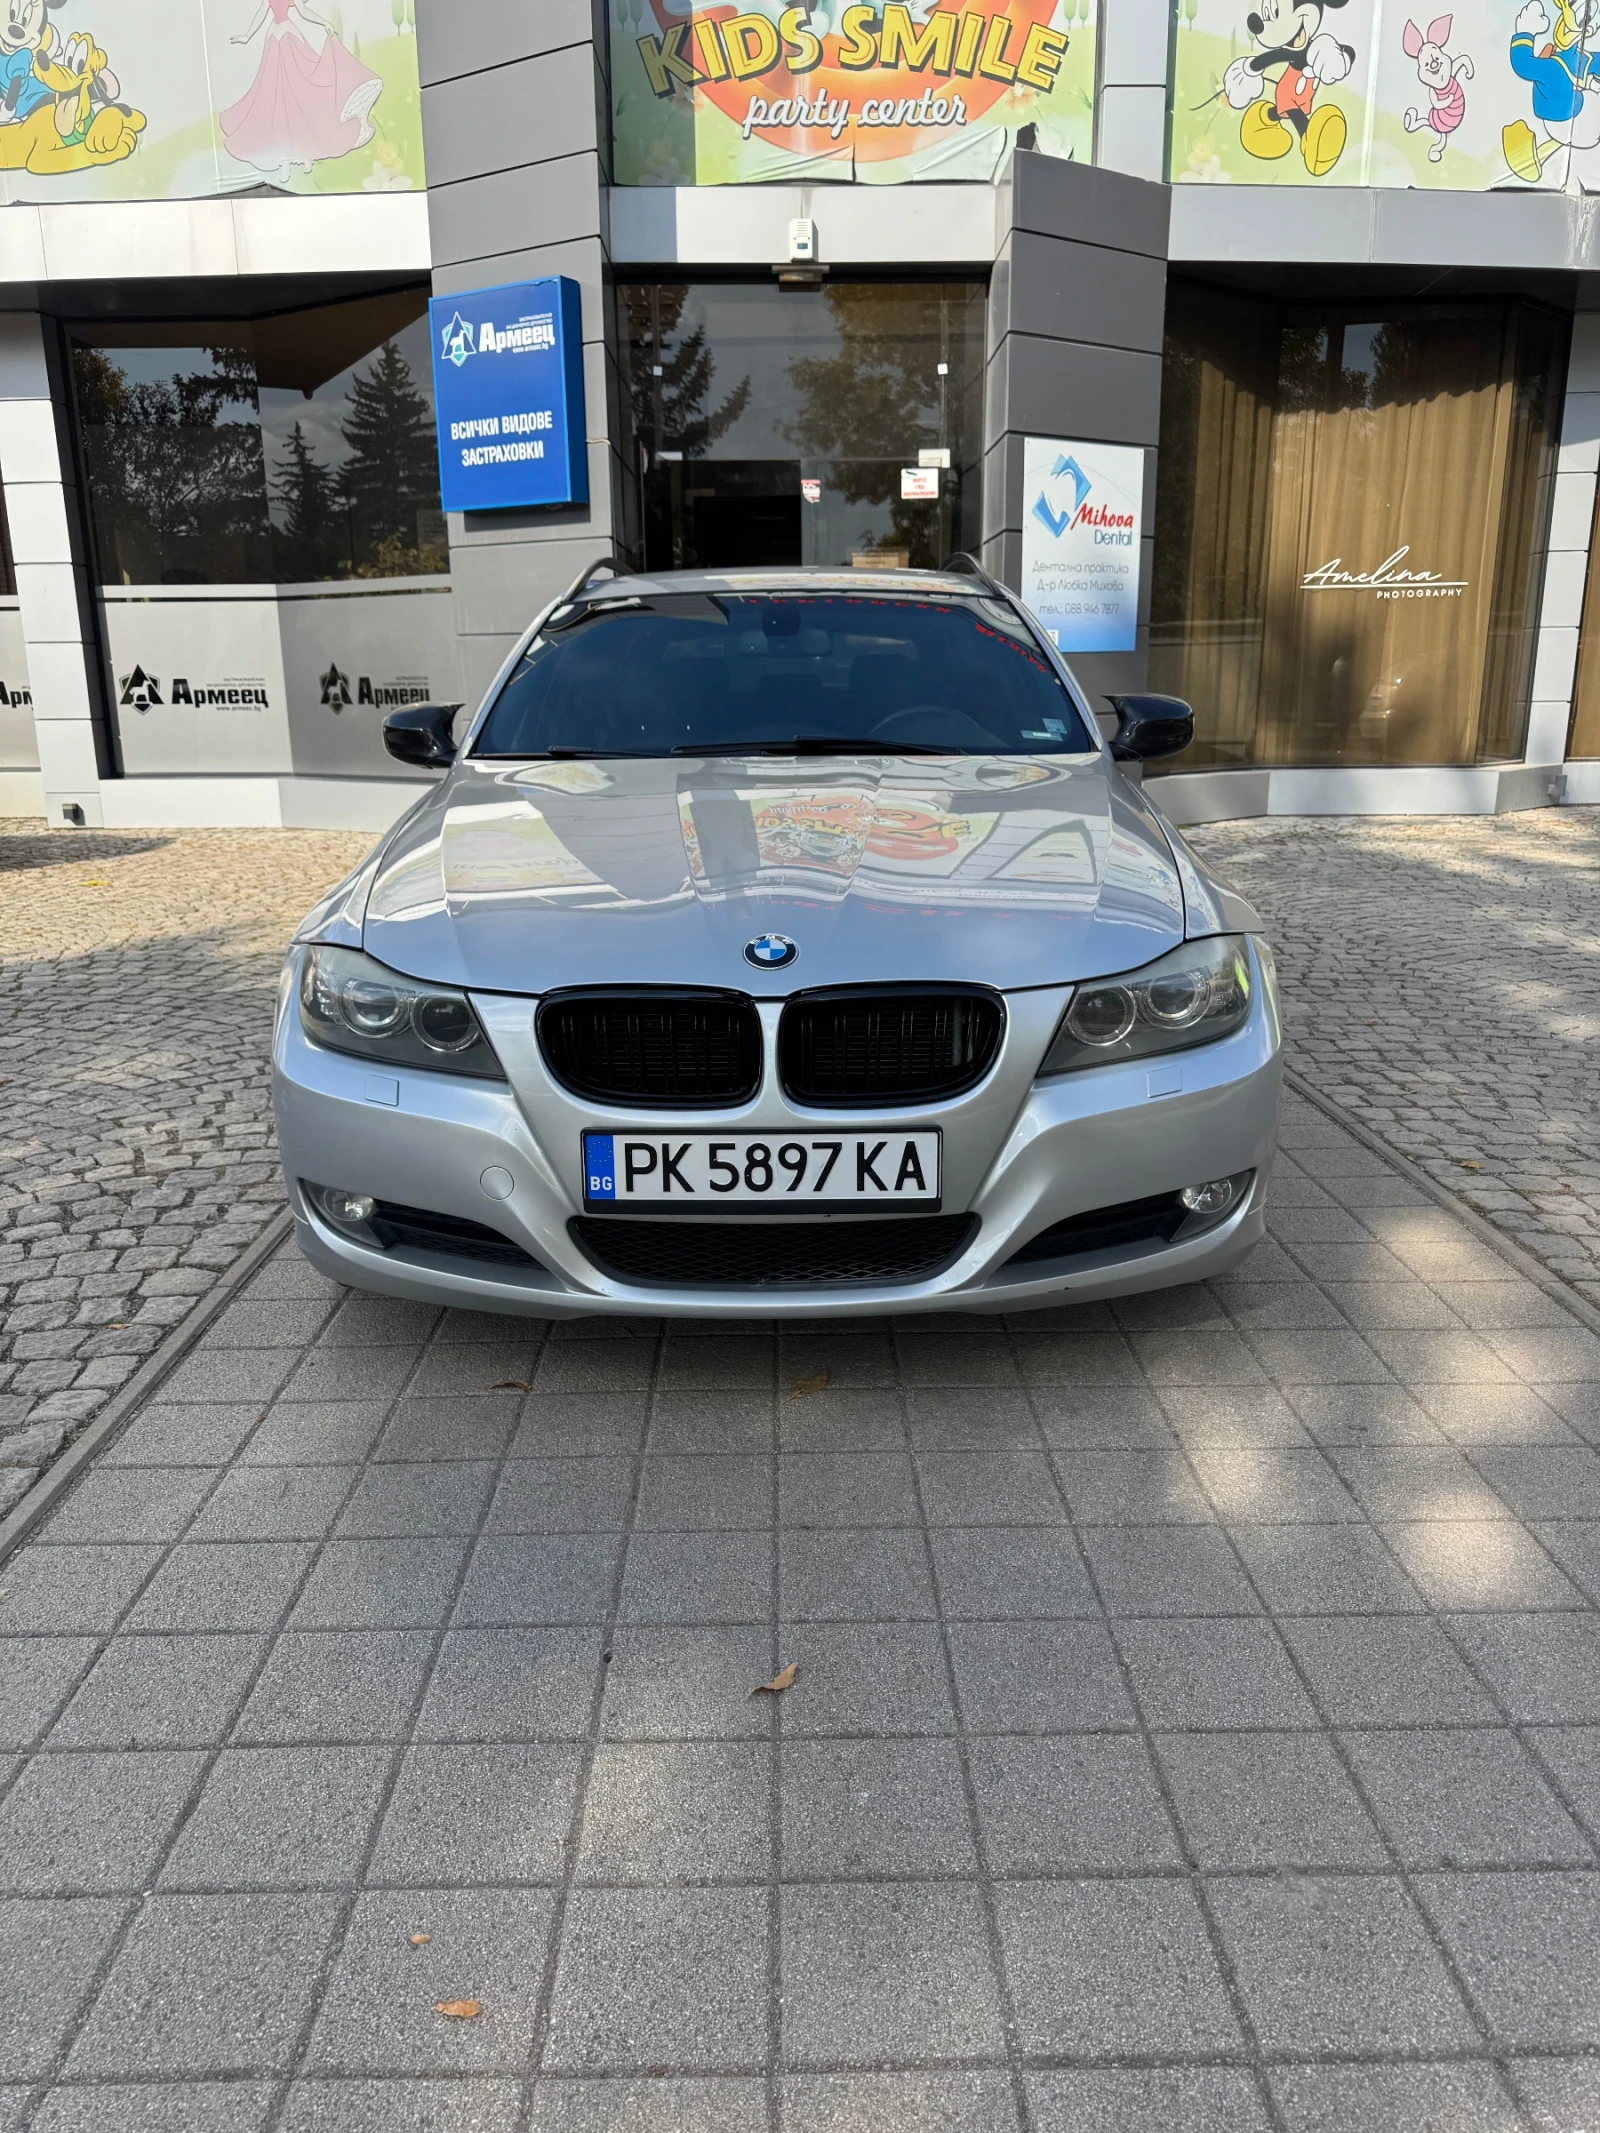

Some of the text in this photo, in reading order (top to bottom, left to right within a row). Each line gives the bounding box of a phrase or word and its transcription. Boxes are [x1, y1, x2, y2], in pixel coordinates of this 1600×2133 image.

[636, 3, 1070, 99] KIDS SMILE
[741, 86, 967, 141] party center
[479, 322, 556, 354] Армеец
[450, 410, 553, 440] ВСИЧКИ ВИДОВЕ
[461, 440, 544, 467] ЗАСТРАХОВКИ
[1094, 529, 1132, 546] Dental
[1032, 560, 1129, 575] Дентална практика
[1303, 545, 1442, 586] Amelina
[1037, 579, 1124, 592] Д-р Любка Михова
[1377, 588, 1463, 599] PHOTOGRAPHY
[1065, 603, 1082, 615] 088
[1083, 603, 1099, 615] 946
[1101, 603, 1120, 615] 7877
[171, 679, 269, 708] Армеец
[624, 1140, 926, 1192] PK 5897 KA
[590, 1176, 612, 1191] BG
